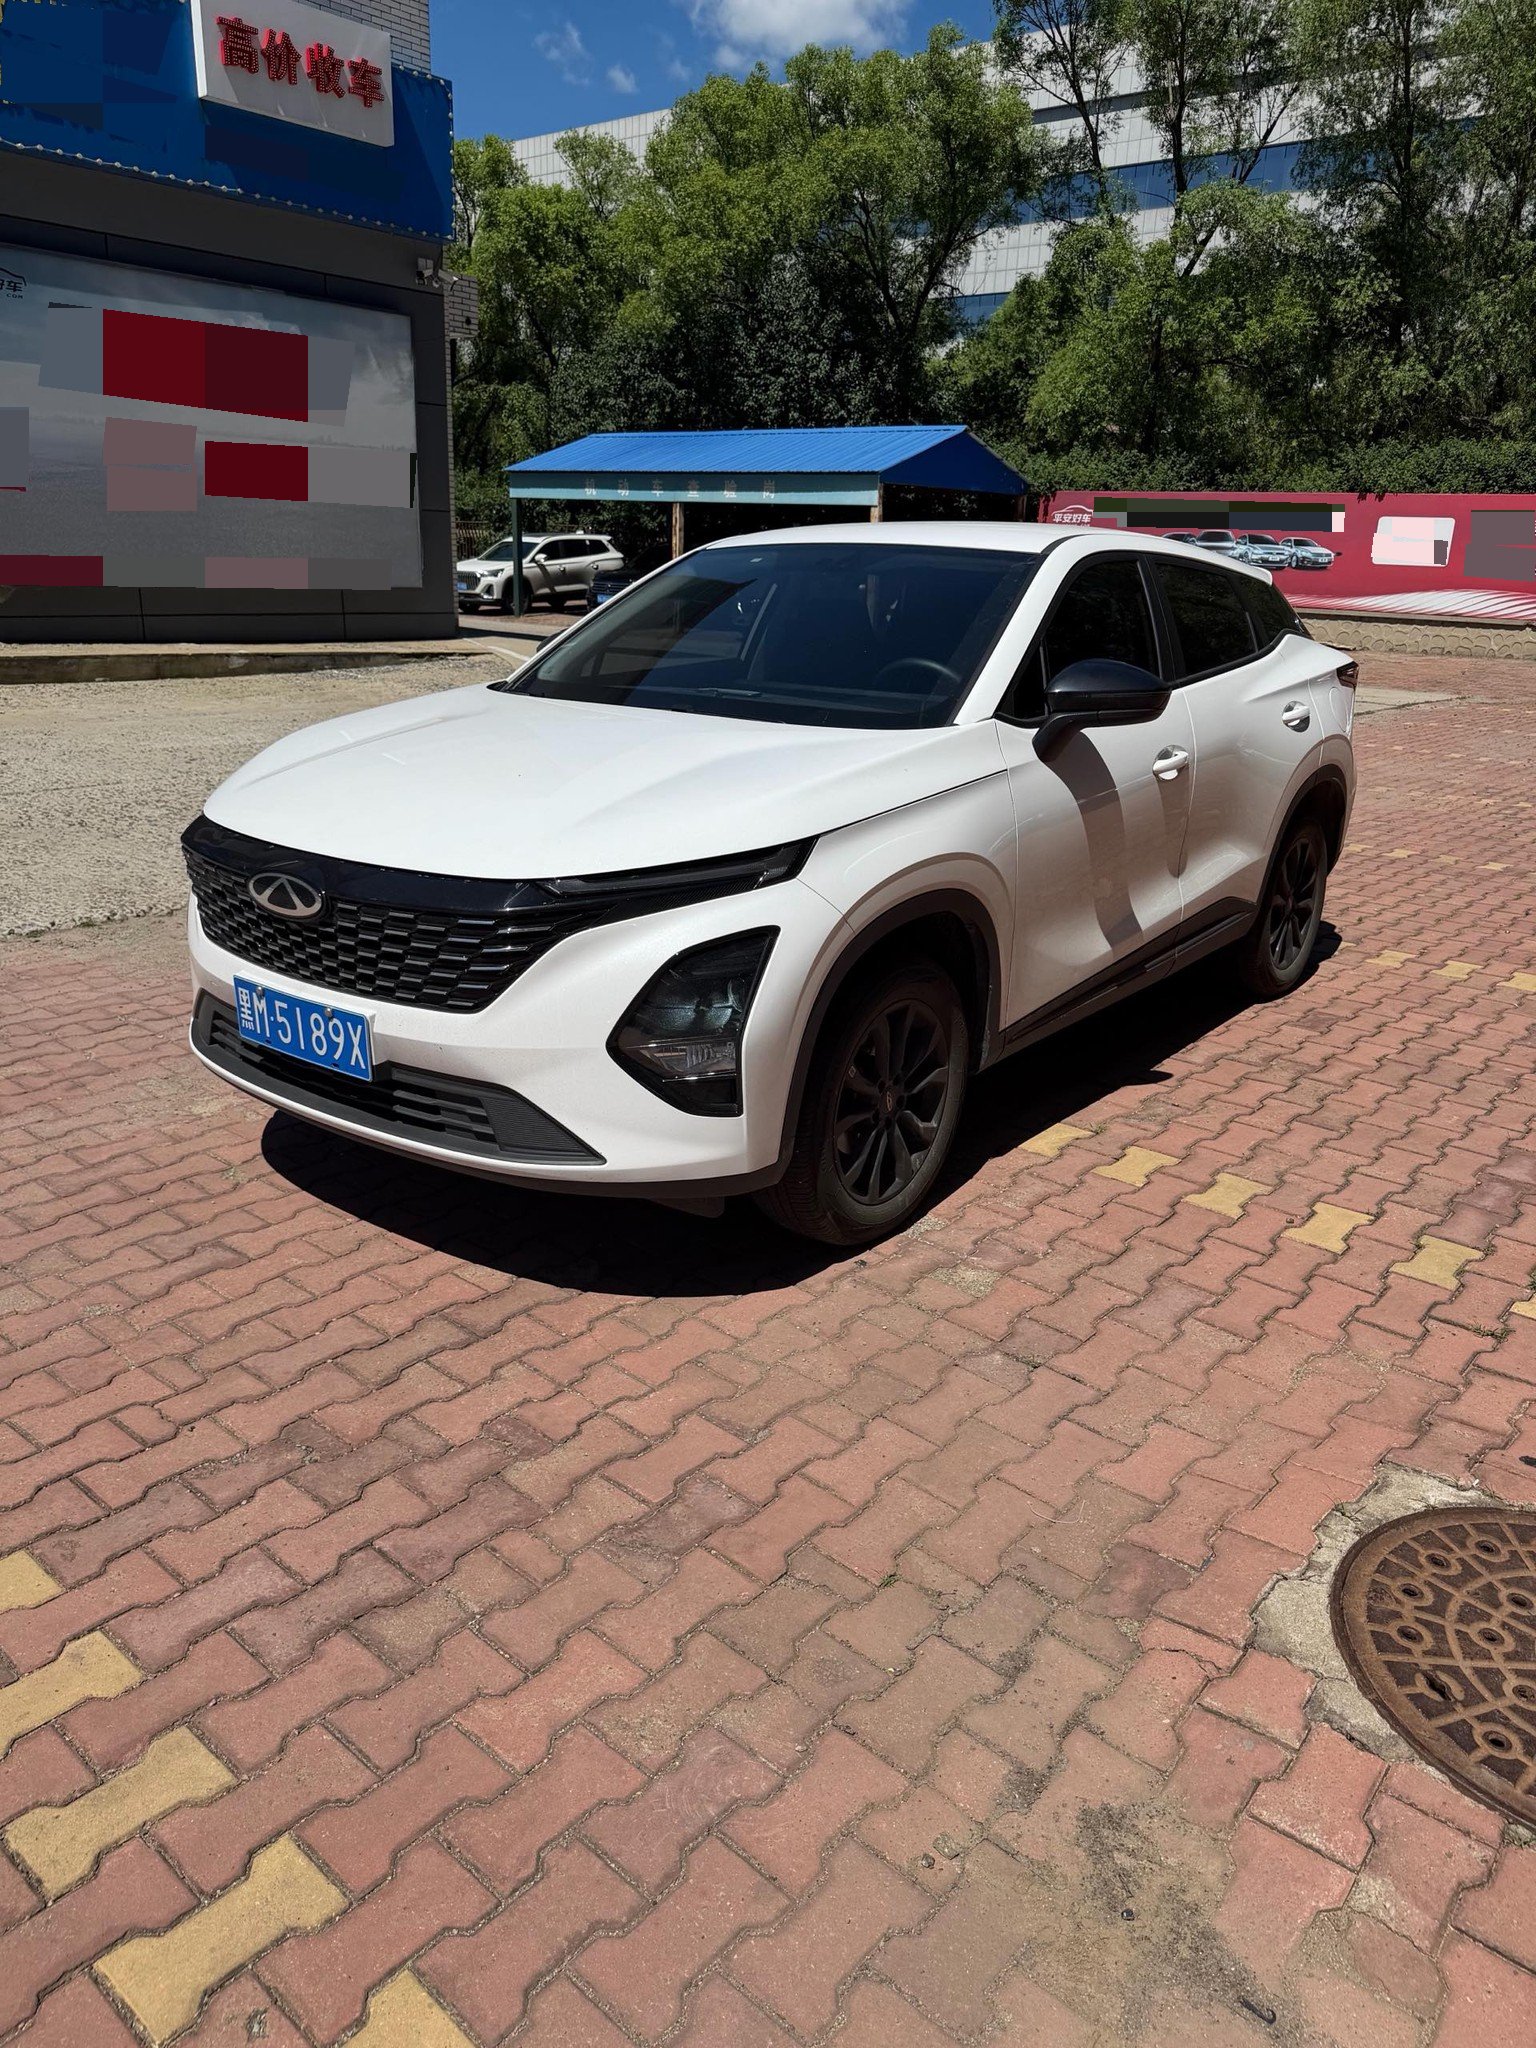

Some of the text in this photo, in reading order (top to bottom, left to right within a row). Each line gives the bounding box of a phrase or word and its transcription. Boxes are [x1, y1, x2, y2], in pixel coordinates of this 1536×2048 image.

[216, 16, 384, 108] 高价收车
[1053, 513, 1092, 523] 平安好车
